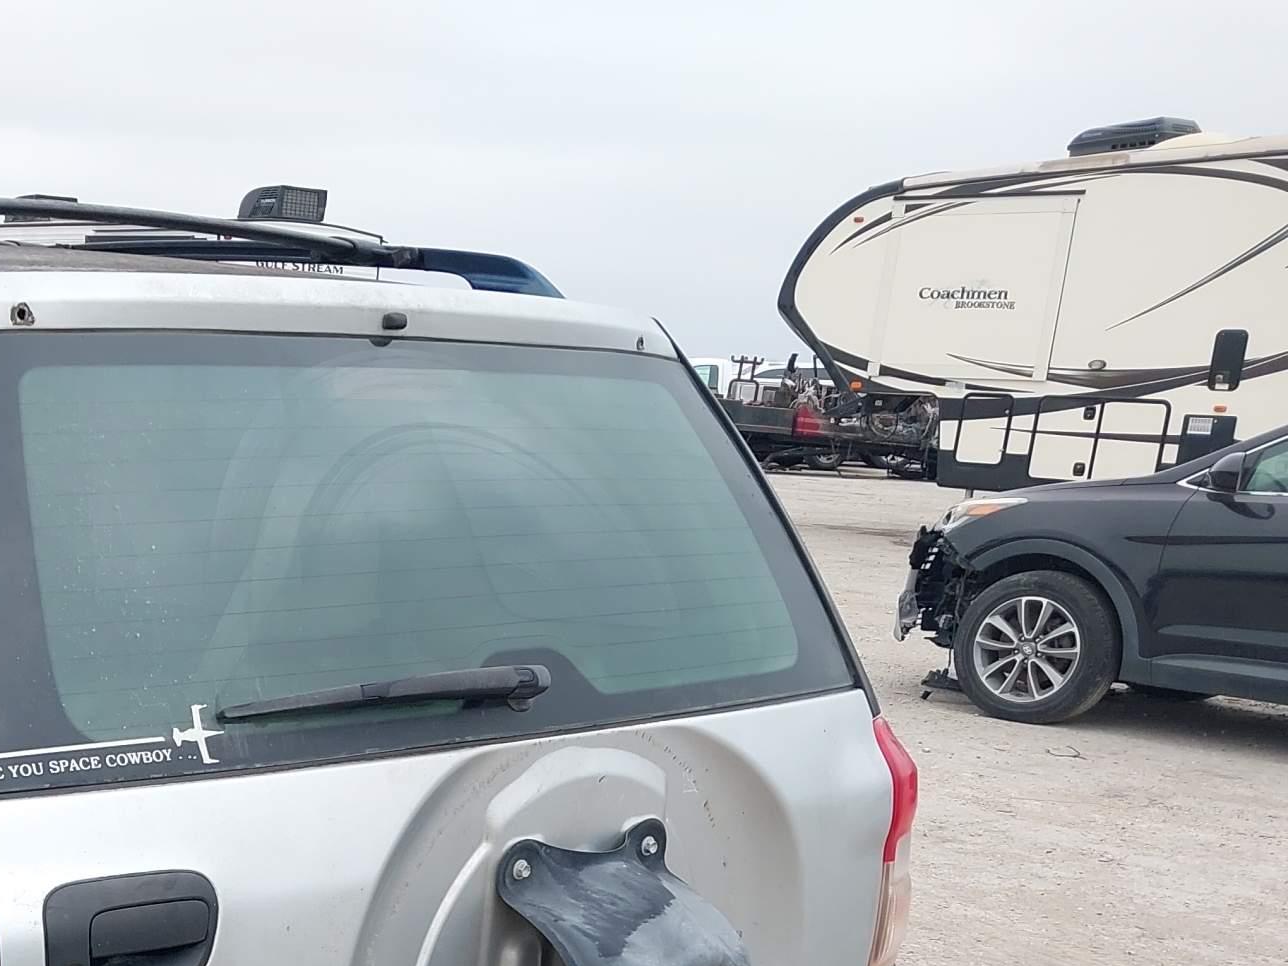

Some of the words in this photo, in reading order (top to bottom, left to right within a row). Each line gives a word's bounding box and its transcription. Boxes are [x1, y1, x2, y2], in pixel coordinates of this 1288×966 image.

[293, 263, 344, 274] STREAM
[919, 286, 1008, 300] Coachmen
[955, 301, 1015, 310] BROOKSTONE
[8, 762, 43, 778] YOU
[49, 756, 101, 774] SPACE
[105, 749, 172, 768] COWBOY
